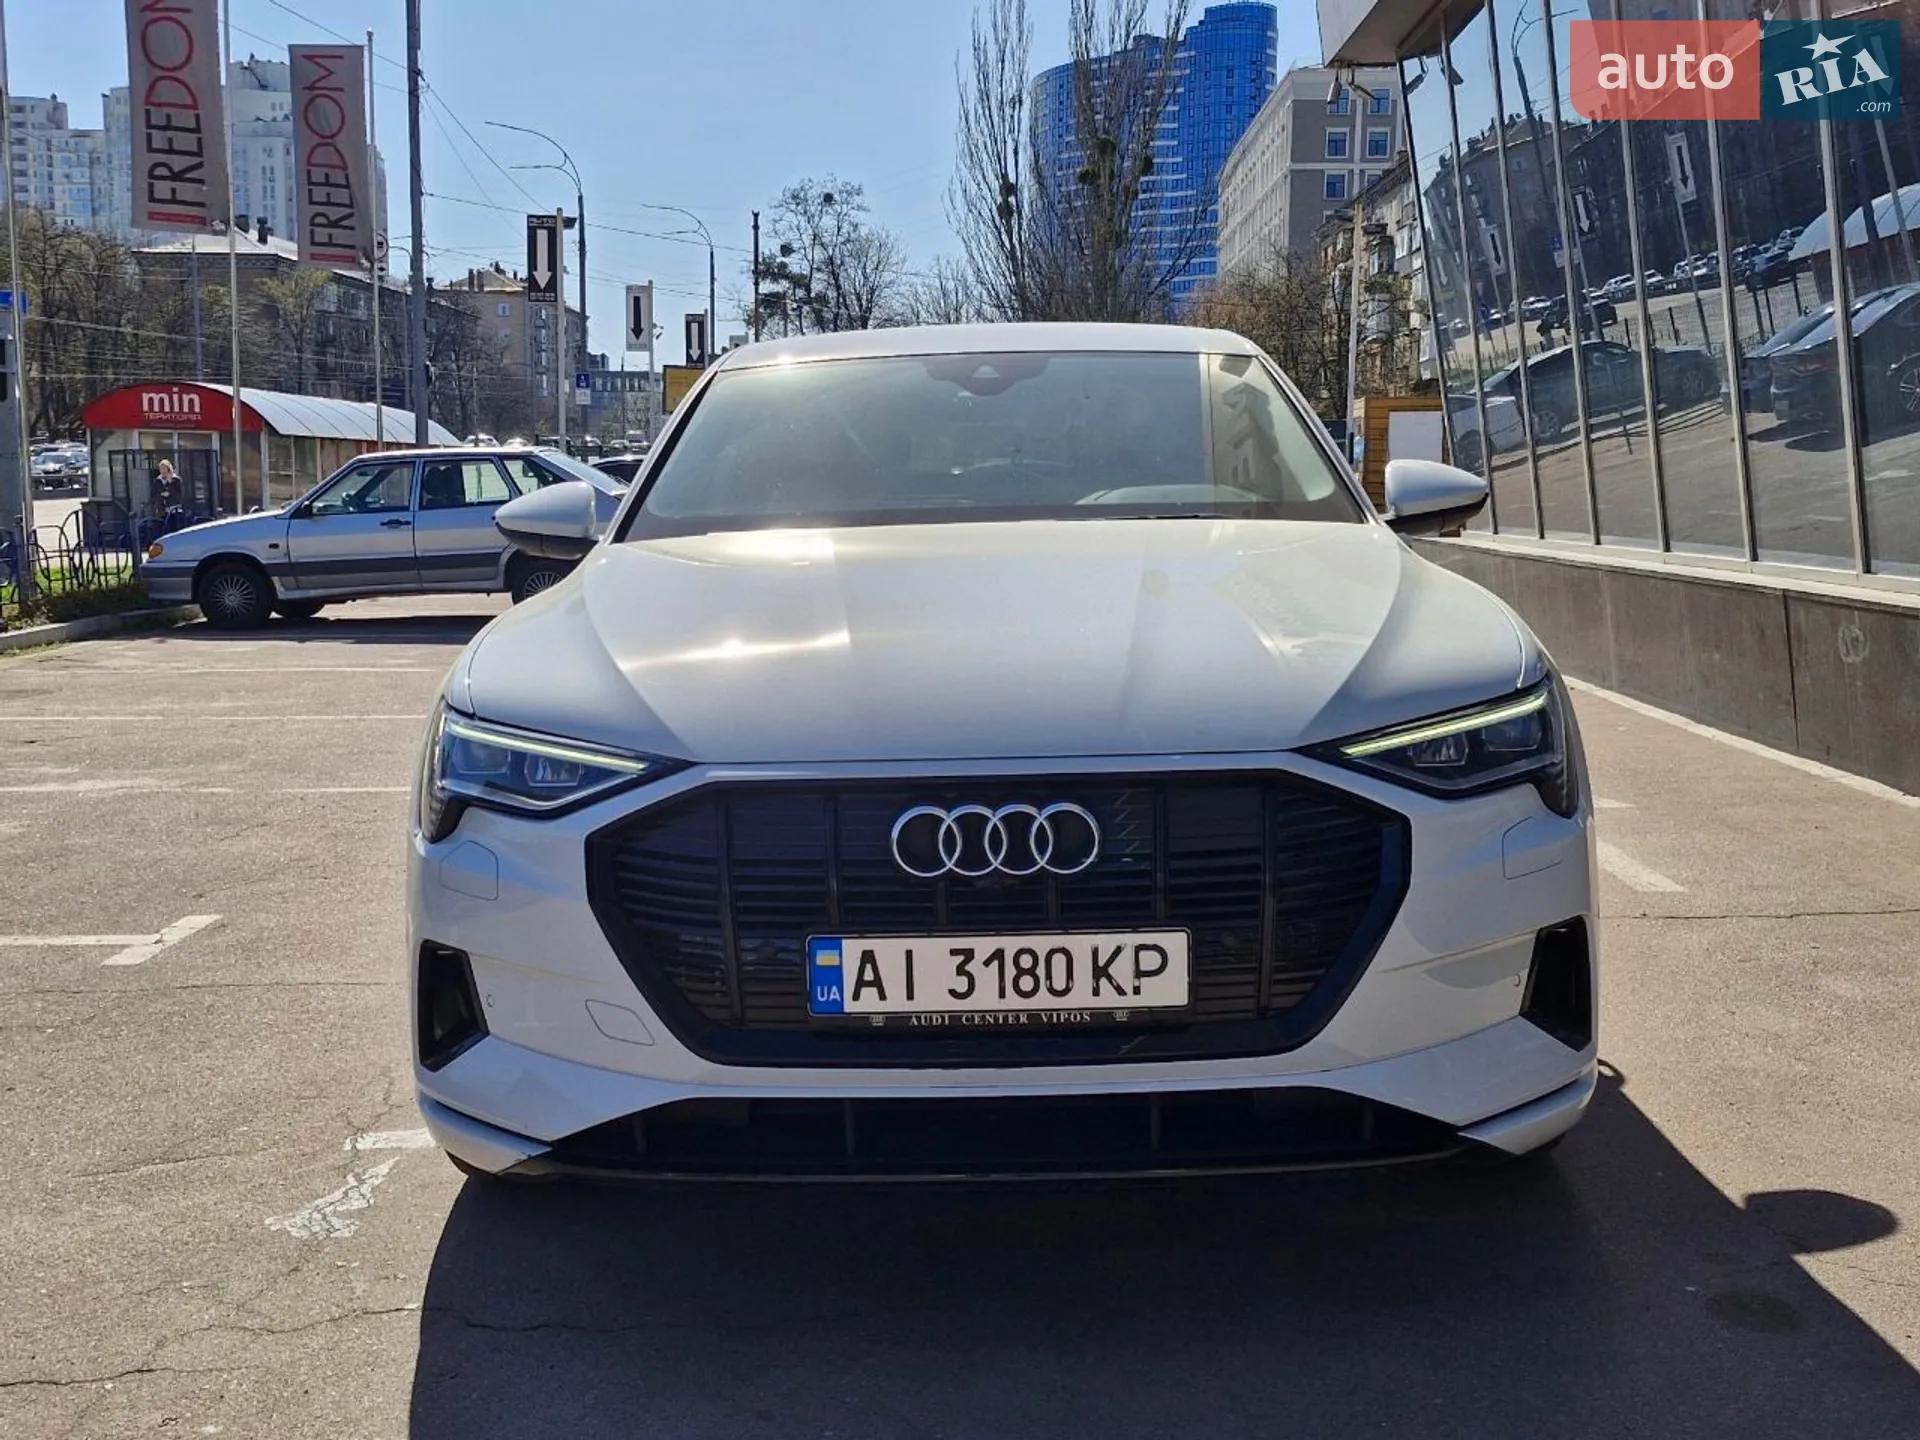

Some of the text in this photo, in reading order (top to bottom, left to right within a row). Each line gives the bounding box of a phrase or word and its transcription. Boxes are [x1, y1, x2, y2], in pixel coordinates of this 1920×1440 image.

[301, 54, 357, 250] FREEDOM
[142, 387, 201, 412] min
[852, 943, 1169, 1001] AI 3180 KP
[816, 985, 842, 1002] UA
[909, 1011, 1091, 1026] AUDI CENTER VIPOS
